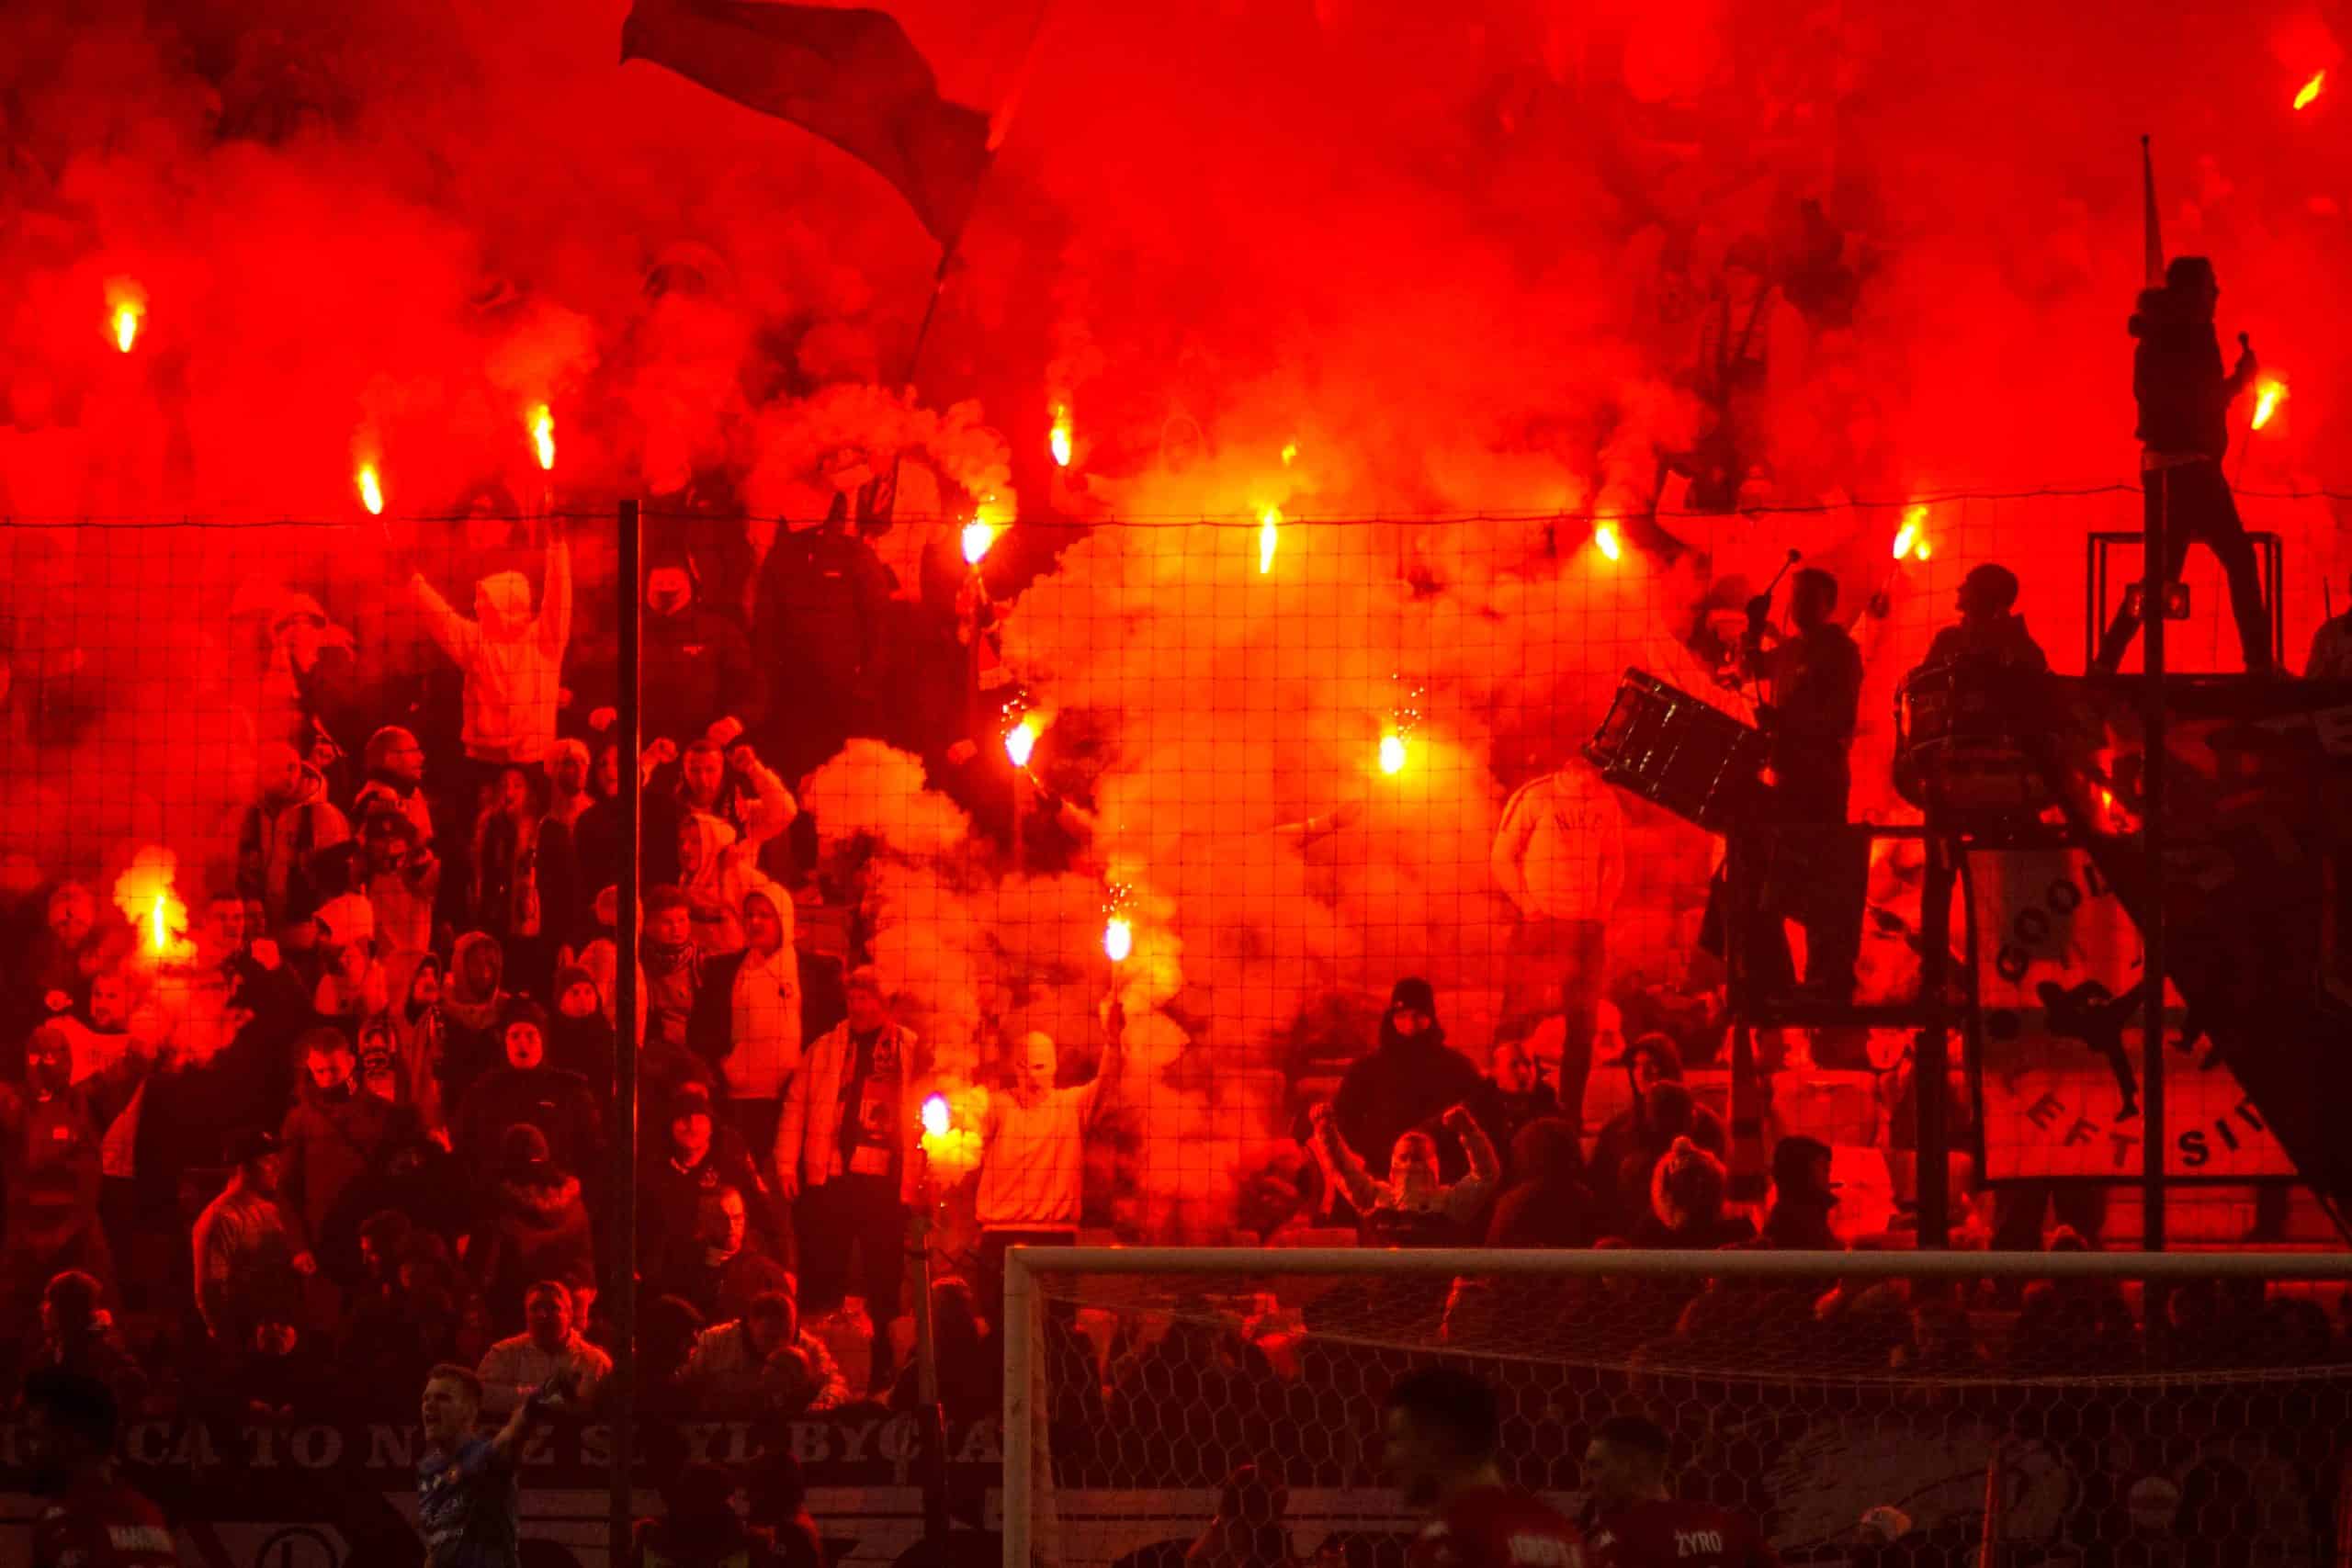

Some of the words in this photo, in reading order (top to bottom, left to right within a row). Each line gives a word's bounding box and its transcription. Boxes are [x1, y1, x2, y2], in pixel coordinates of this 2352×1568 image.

[243, 1424, 344, 1469] TO
[364, 1423, 556, 1468] NZ
[580, 1422, 765, 1467] SYL
[786, 1418, 1003, 1462] BYCA
